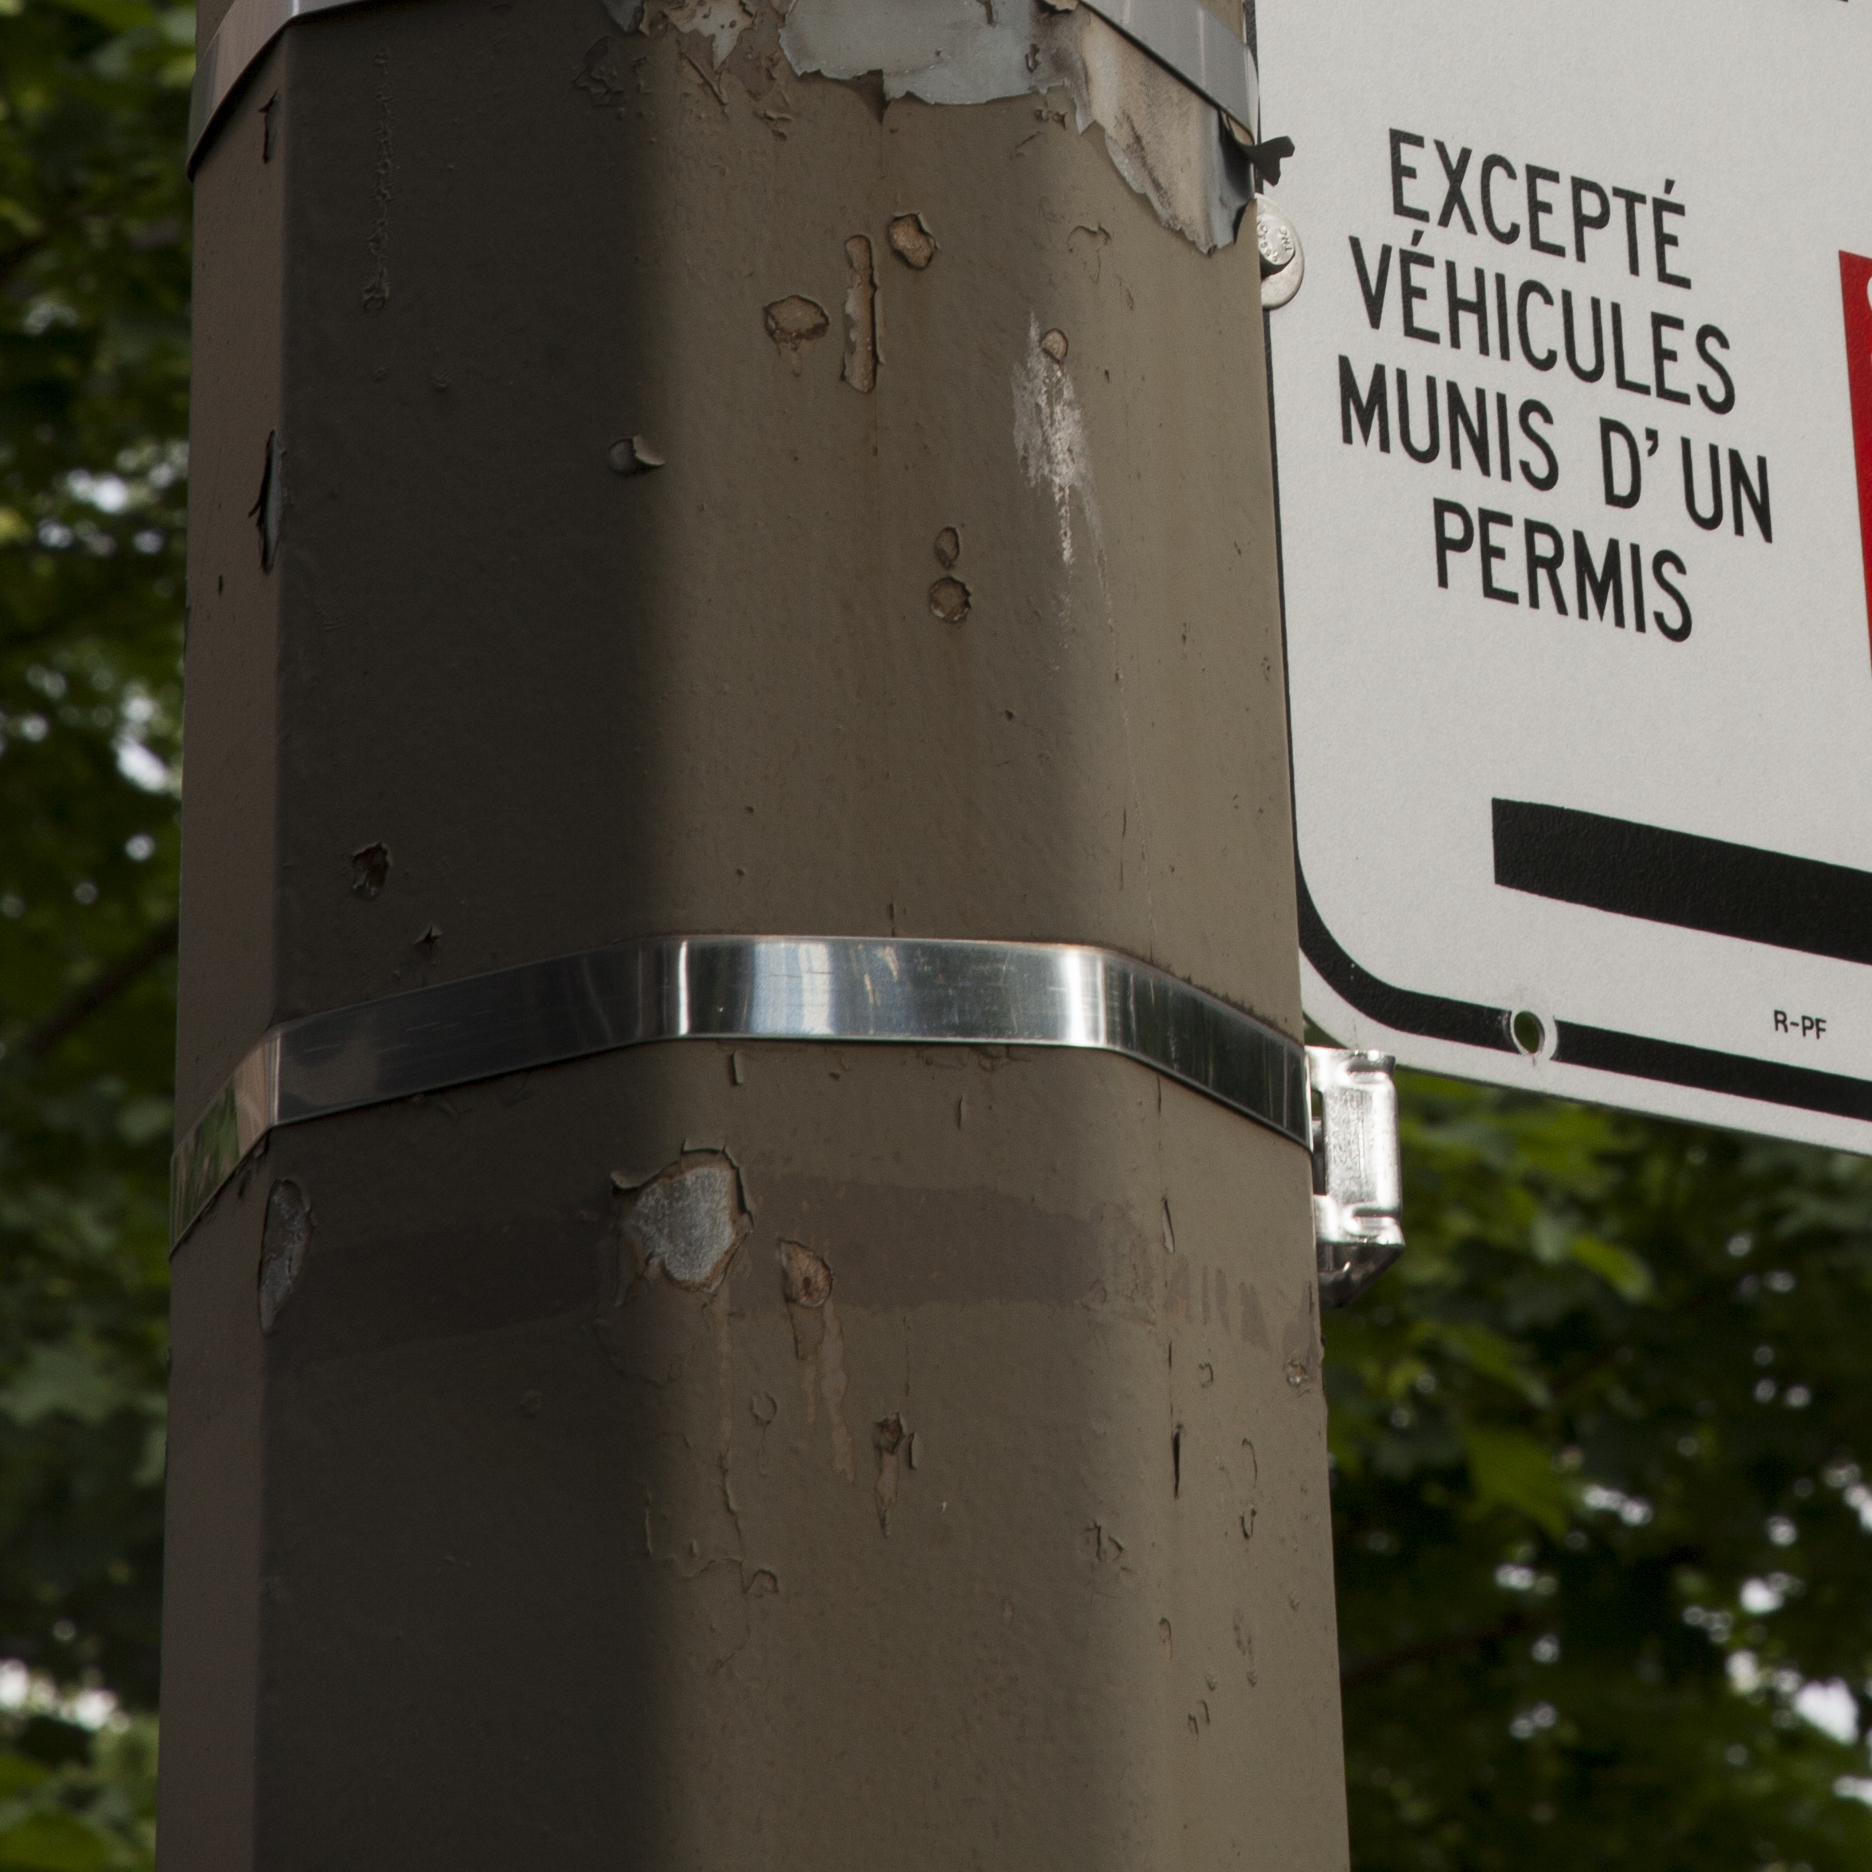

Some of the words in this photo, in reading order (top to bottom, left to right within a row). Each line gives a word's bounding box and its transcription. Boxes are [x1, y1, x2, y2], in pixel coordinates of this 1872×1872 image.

[1389, 128, 1692, 290] EXCEPTÉ
[1348, 228, 1736, 415] VÉHICULES
[1338, 354, 1559, 492] MUNIS
[1433, 497, 1693, 643] PERMIS
[1773, 1009, 1827, 1040] R-PF
